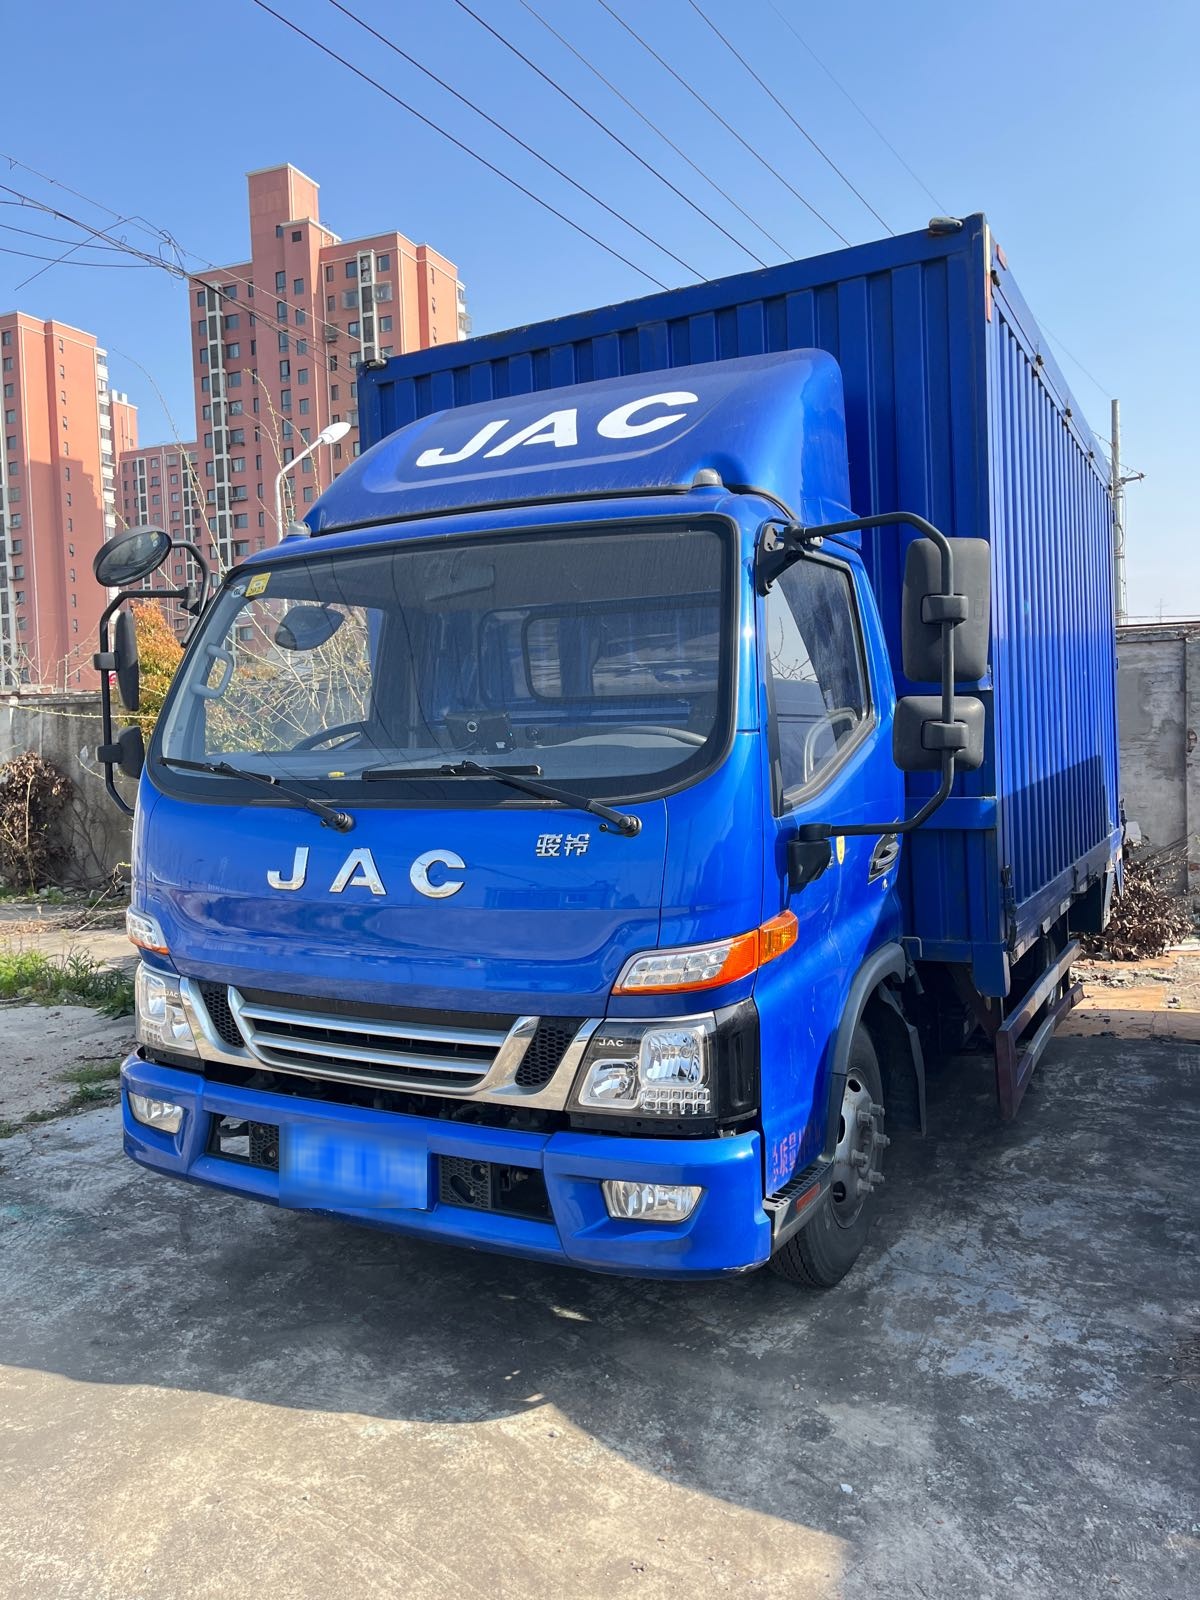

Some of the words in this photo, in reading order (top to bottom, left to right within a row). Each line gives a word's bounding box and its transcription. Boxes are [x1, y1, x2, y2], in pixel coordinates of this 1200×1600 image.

[416, 391, 699, 467] JAC
[536, 833, 590, 857] 骏铃
[267, 847, 466, 898] JAC
[598, 1039, 624, 1047] JAC
